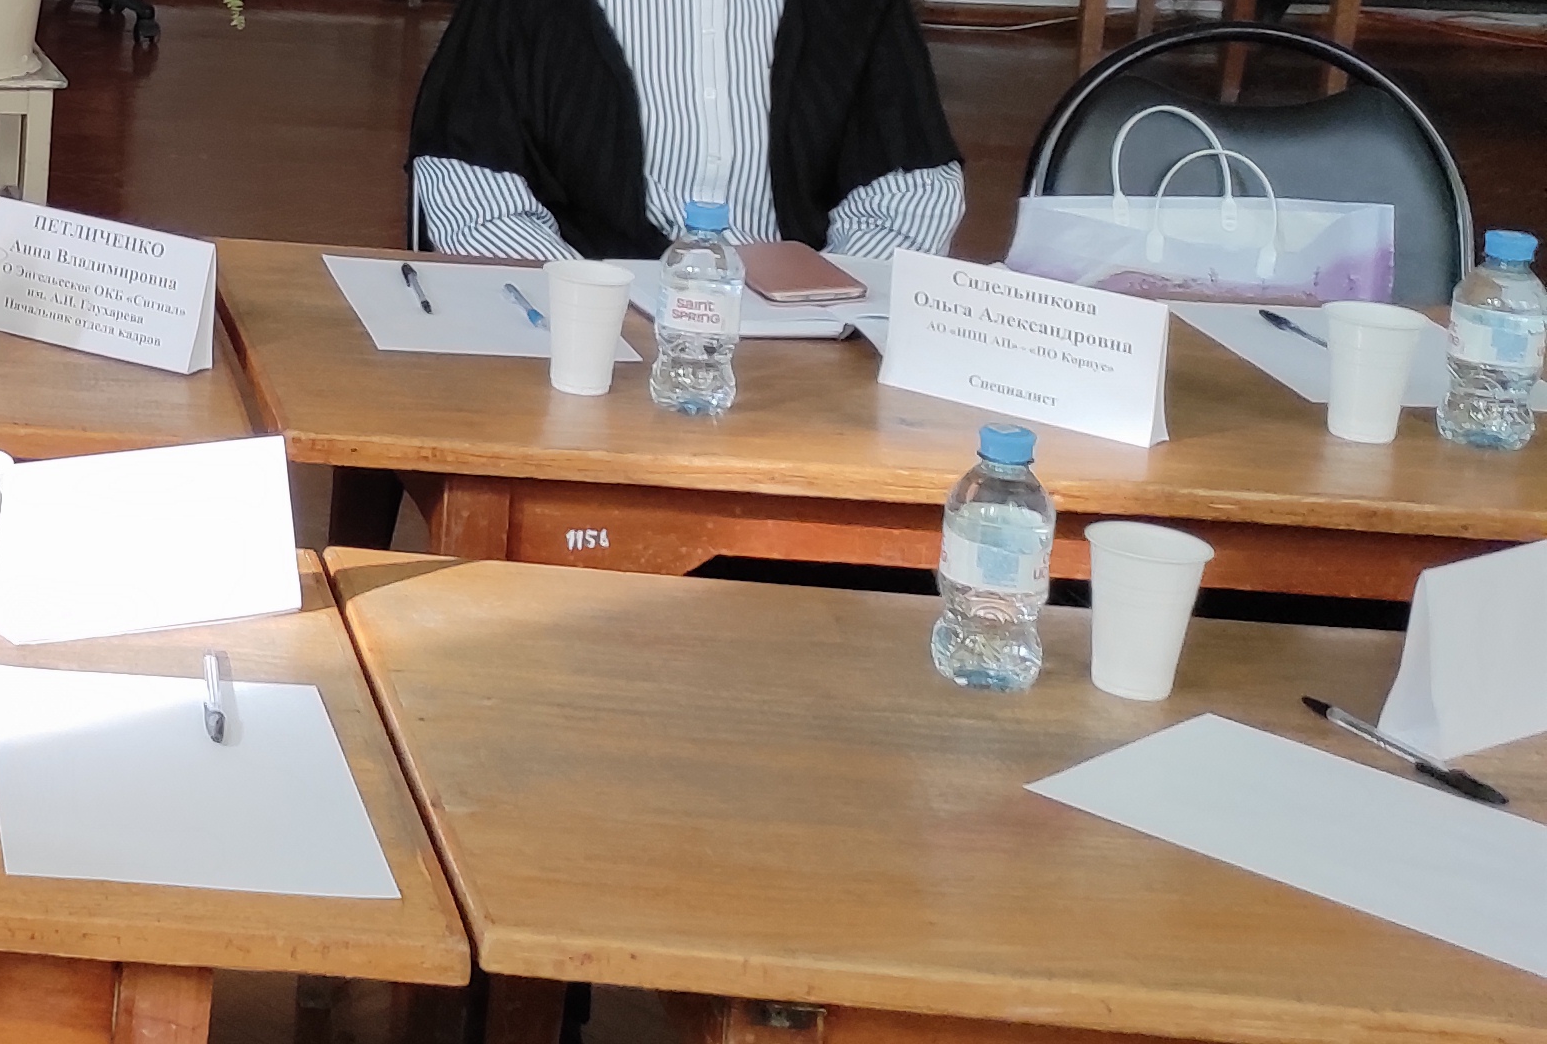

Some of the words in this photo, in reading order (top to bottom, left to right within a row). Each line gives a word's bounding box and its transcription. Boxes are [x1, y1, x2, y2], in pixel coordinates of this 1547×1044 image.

[33, 214, 166, 258] ПЕТЛИЧЕНКО
[2, 262, 14, 274] О
[93, 284, 124, 302] ОКБ
[9, 239, 52, 261] Анна
[56, 248, 179, 291] Владимировна
[80, 299, 144, 325] Глухарева
[952, 270, 1097, 317] Сидельникова
[4, 296, 73, 325] Начальник
[74, 317, 116, 336] отдела
[117, 328, 162, 347] кадров
[913, 290, 973, 318] Ольга
[978, 306, 1133, 355] Александровна
[926, 319, 947, 335] АО
[967, 374, 1058, 407] Специалист
